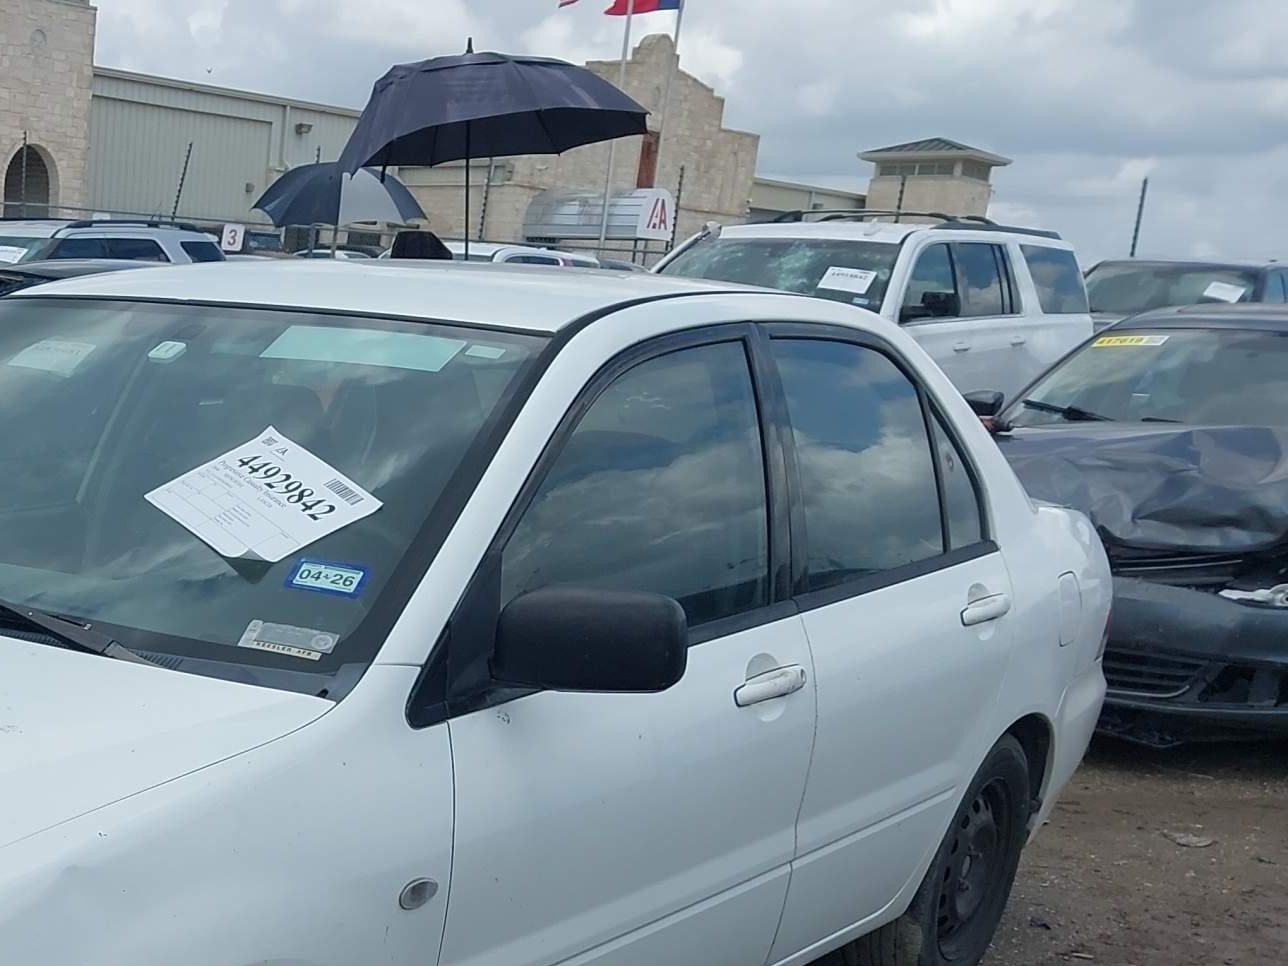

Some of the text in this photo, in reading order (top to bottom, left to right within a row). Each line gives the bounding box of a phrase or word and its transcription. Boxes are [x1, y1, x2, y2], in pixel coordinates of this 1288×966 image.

[227, 229, 238, 246] 3
[237, 455, 337, 522] 44929842
[298, 568, 356, 587] 04 26
